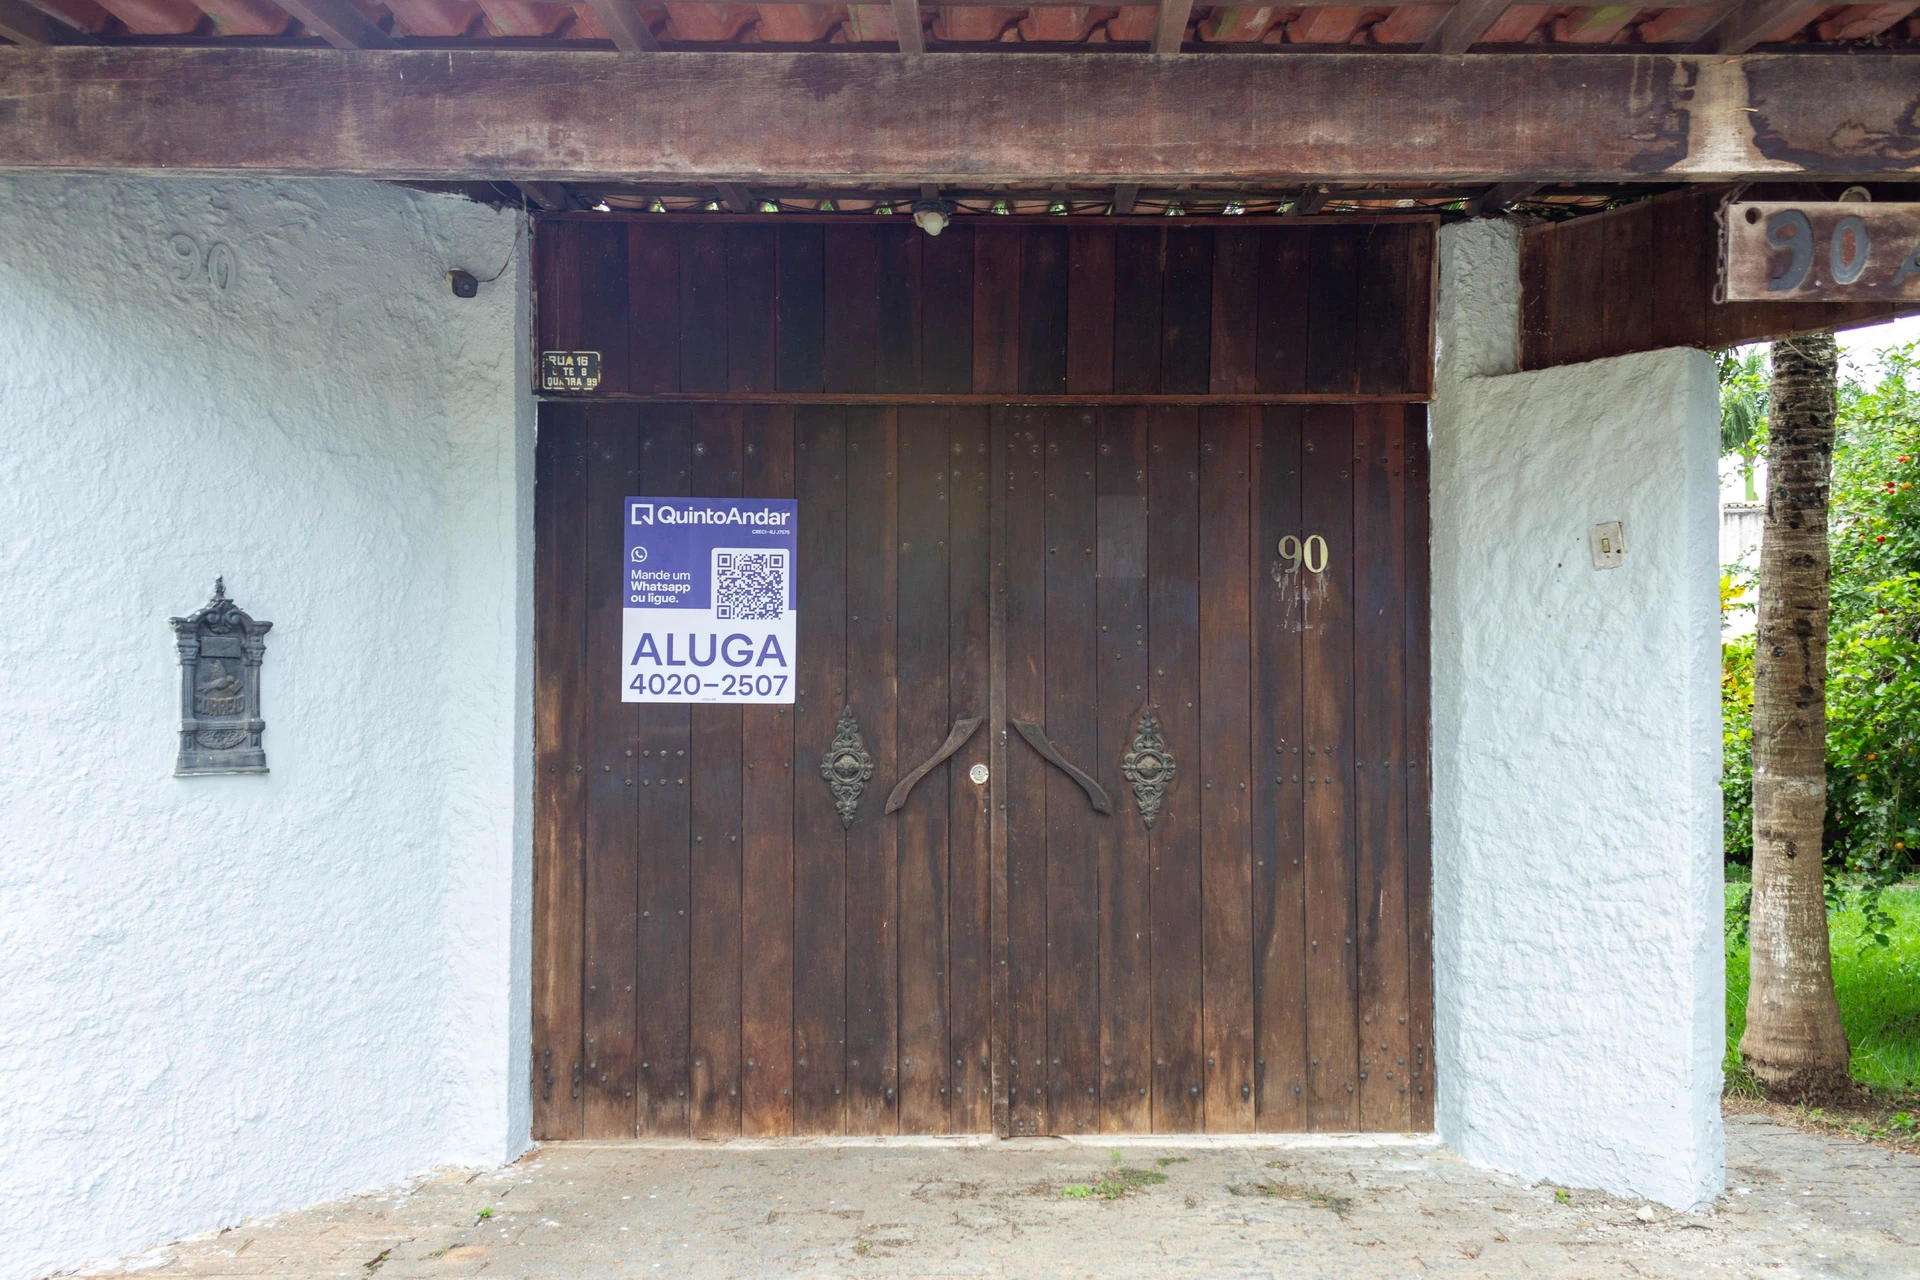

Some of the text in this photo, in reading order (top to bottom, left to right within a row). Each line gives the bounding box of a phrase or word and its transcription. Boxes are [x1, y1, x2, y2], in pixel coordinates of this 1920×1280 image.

[168, 233, 237, 295] 90
[548, 355, 588, 366] RUA 16
[581, 367, 587, 376] 8
[586, 377, 598, 387] 99
[657, 505, 791, 526] QuintoAndar
[1278, 534, 1328, 574] 90
[631, 569, 691, 581] Mande um
[631, 581, 691, 594] Whatsapp
[630, 593, 679, 605] ou ligue.
[630, 632, 788, 668] ALUGA
[629, 673, 788, 696] 4020-2507
